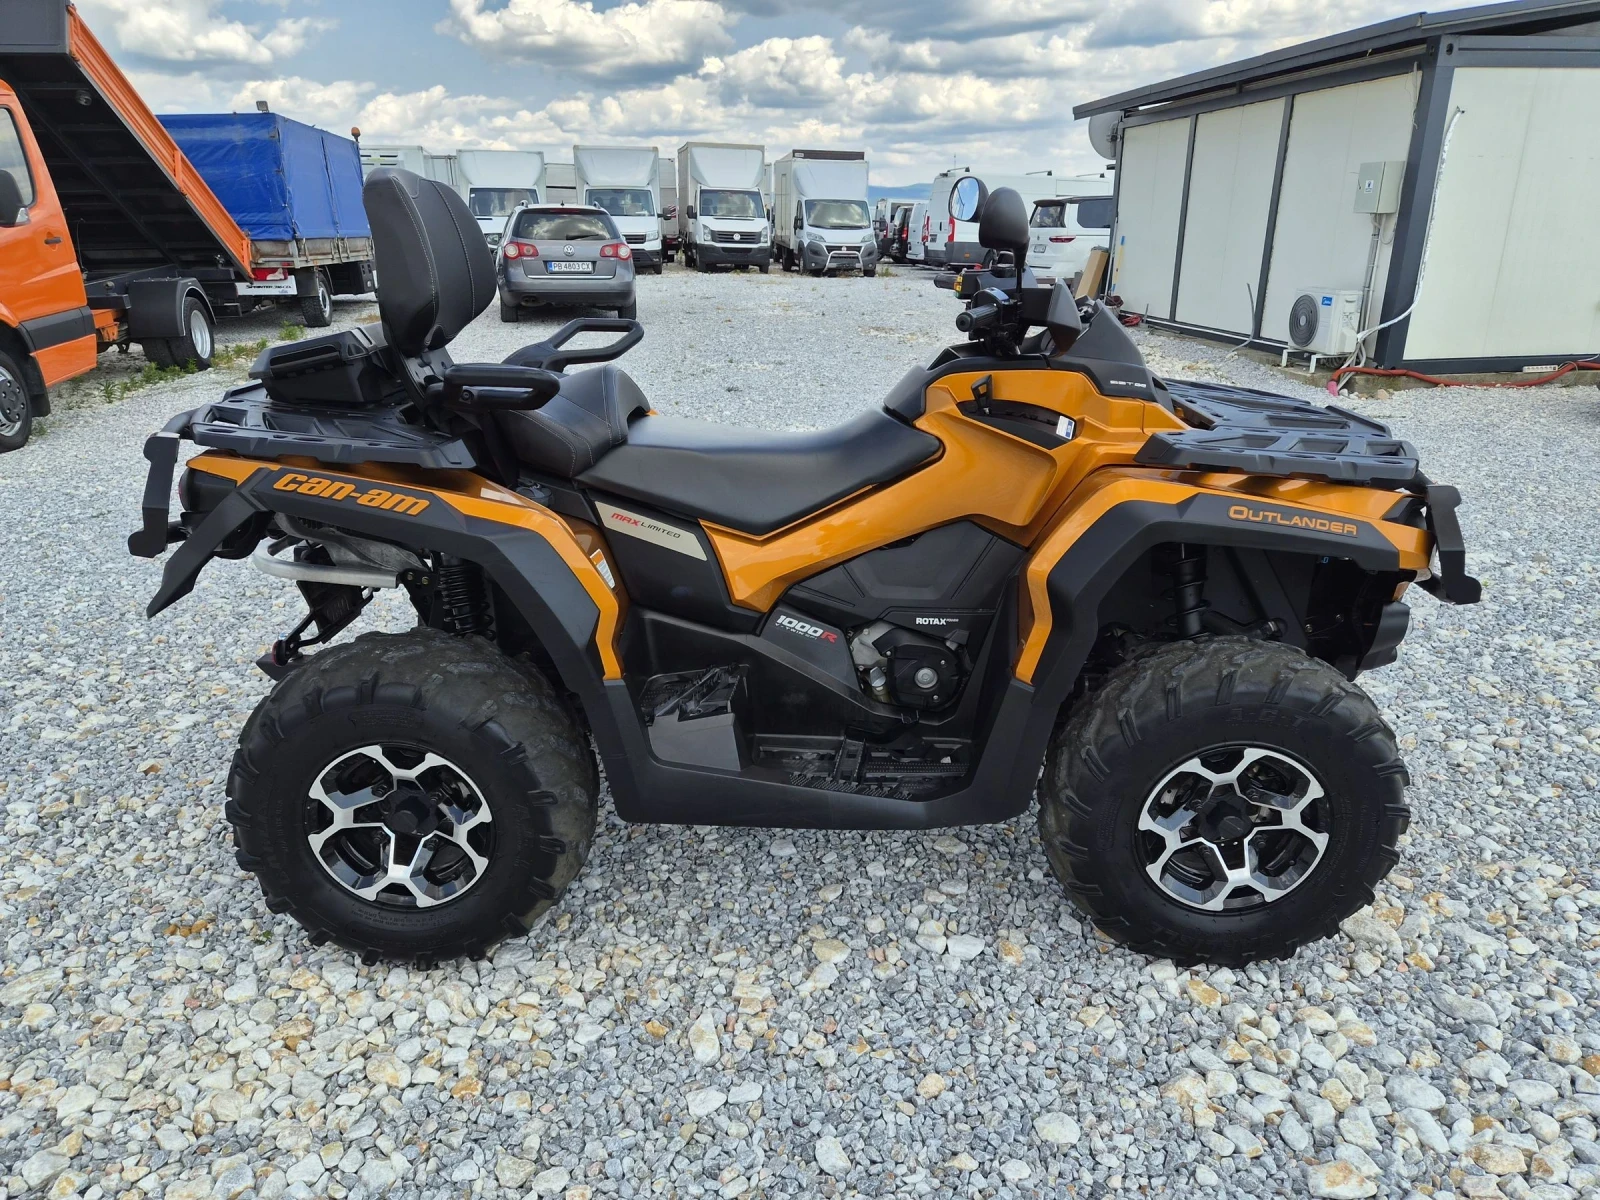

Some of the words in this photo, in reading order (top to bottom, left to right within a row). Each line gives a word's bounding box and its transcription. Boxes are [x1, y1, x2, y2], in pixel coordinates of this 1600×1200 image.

[553, 262, 563, 270] PB
[563, 262, 580, 270] 4803
[581, 262, 590, 270] CX
[611, 512, 641, 527] MAX
[641, 521, 681, 539] LIMITED
[776, 614, 838, 644] 1000R
[915, 617, 947, 626] ROTAX
